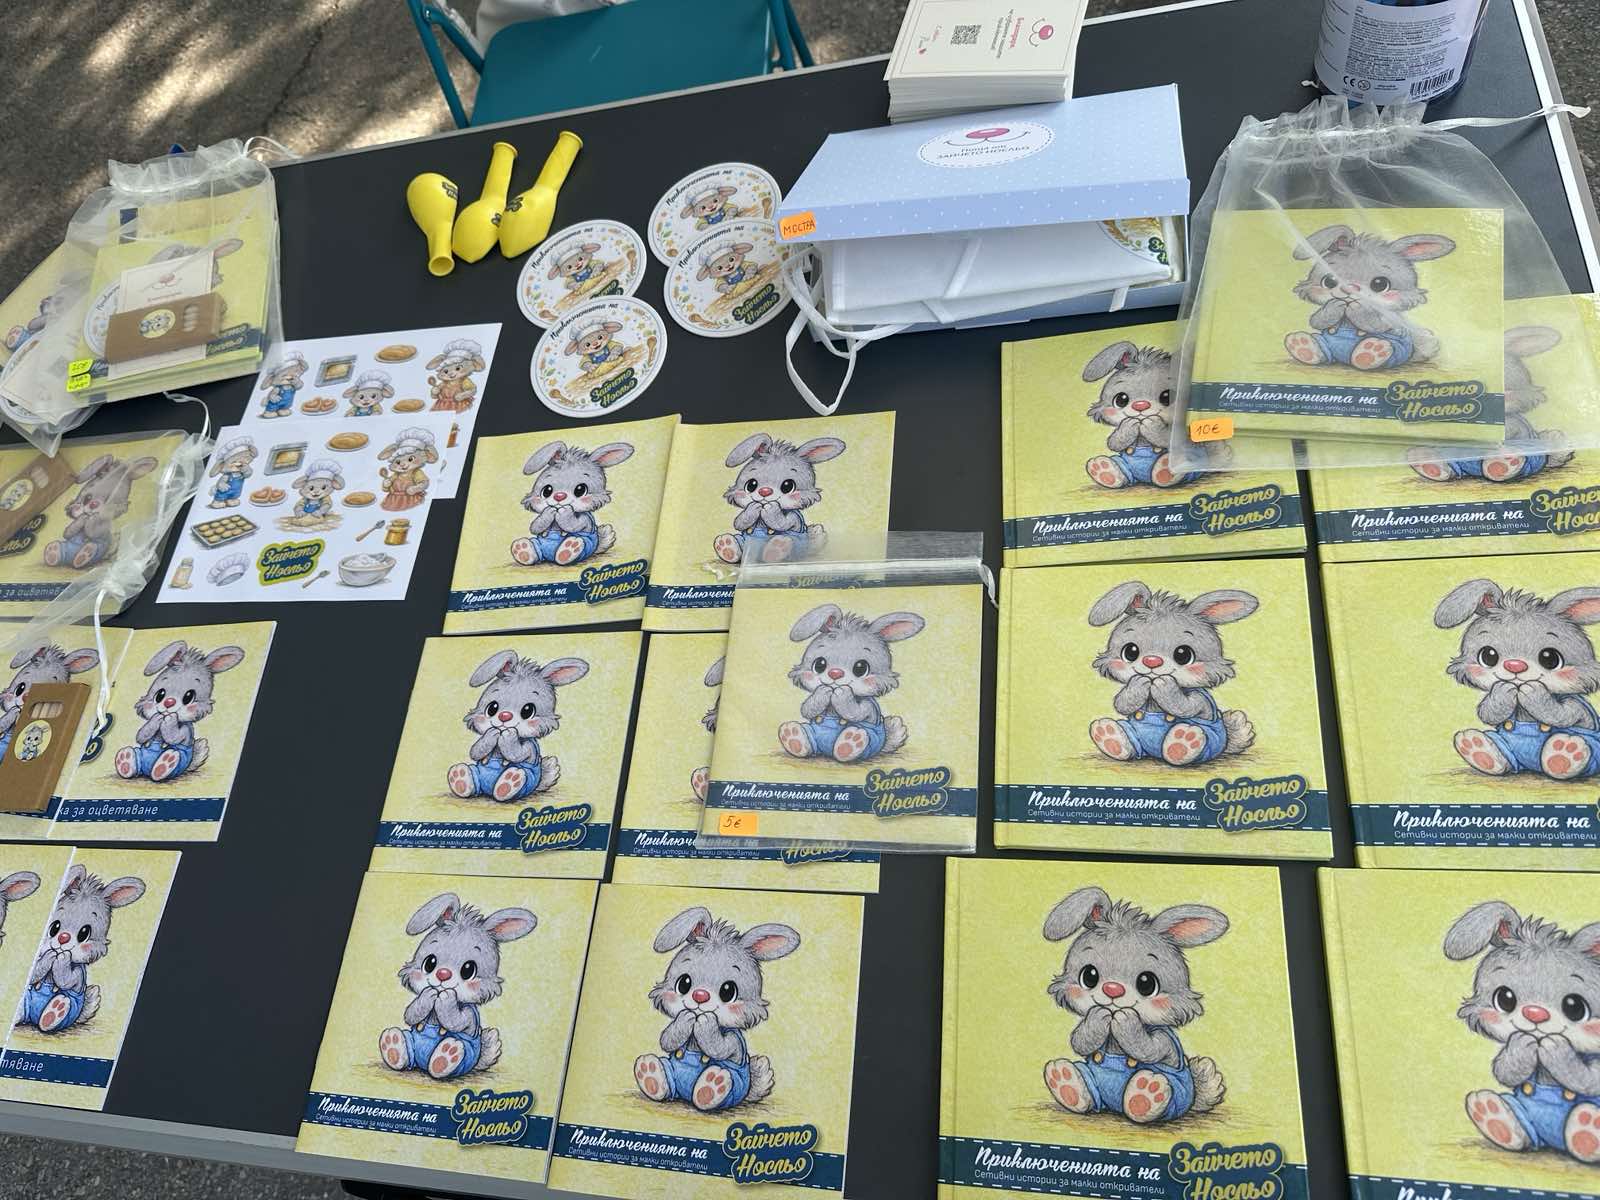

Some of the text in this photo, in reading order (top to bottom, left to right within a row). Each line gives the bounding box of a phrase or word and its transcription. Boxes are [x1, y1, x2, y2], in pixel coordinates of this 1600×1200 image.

[665, 170, 719, 206] Приключенията
[783, 219, 816, 235] МОСТРА
[531, 229, 581, 270] Приключенията
[678, 227, 731, 270] Приключенията
[732, 284, 773, 319] Зайчето
[745, 293, 779, 323] Носльо
[549, 303, 606, 341] Приключенията
[590, 369, 632, 401] Зайчето
[601, 378, 636, 408] Носльо
[1219, 387, 1379, 405] Приключенията на
[1391, 382, 1478, 401] Зайчето
[1402, 403, 1475, 418] Носльо
[1195, 423, 1221, 435] 10€
[1193, 487, 1276, 516] Зайчето
[1536, 490, 1600, 513] Зайче
[1032, 513, 1184, 536] Приключенията на
[1207, 506, 1276, 532] Носльо
[1351, 509, 1525, 531] Приключенията на
[1351, 521, 1530, 537] Сетивни истории за малки откриватели
[1032, 534, 1066, 543] Сетивни
[1066, 532, 1100, 541] истории
[1110, 529, 1133, 537] малки
[1134, 524, 1188, 535] откриватели
[263, 543, 320, 566] Зайчето
[264, 560, 313, 580] Носльо
[582, 561, 644, 586] Зайчето
[462, 587, 568, 604] Приключенията на
[588, 578, 641, 600] Носльо
[662, 587, 735, 602] Приключени
[721, 783, 850, 801] Приключенията на
[868, 770, 946, 794] Зайчето
[1209, 778, 1300, 804] Зайчето
[58, 804, 159, 818] ка за оцветяване
[877, 791, 942, 813] Носльо
[1027, 790, 1198, 810] Приключенията на
[519, 806, 588, 831] Зайчето
[722, 816, 742, 829] 5€
[1027, 809, 1201, 821] Сетивни истории за малки откриватели
[1223, 803, 1300, 828] Носльо
[1392, 808, 1591, 831] Приключенията на
[389, 824, 504, 840] Приключенията на
[525, 827, 582, 849] Носльо
[1394, 830, 1597, 842] Сетивни истории за малки откриватели
[1, 1057, 44, 1073] тяване
[318, 1096, 439, 1123] Приключенията на
[455, 1093, 529, 1116] Зайчето
[461, 1116, 522, 1140] Носльо
[727, 1127, 812, 1152] Зайчето
[569, 1127, 709, 1160] Приключенията на
[568, 1146, 709, 1171] Сетивни истории за малки откриватели
[736, 1154, 806, 1178] Носльо
[974, 1145, 1161, 1181] Приключенията на
[1174, 1146, 1276, 1178] Зайчето
[974, 1168, 1165, 1196] Сетивни истории за малки откриватели
[1191, 1175, 1276, 1200] Носльо
